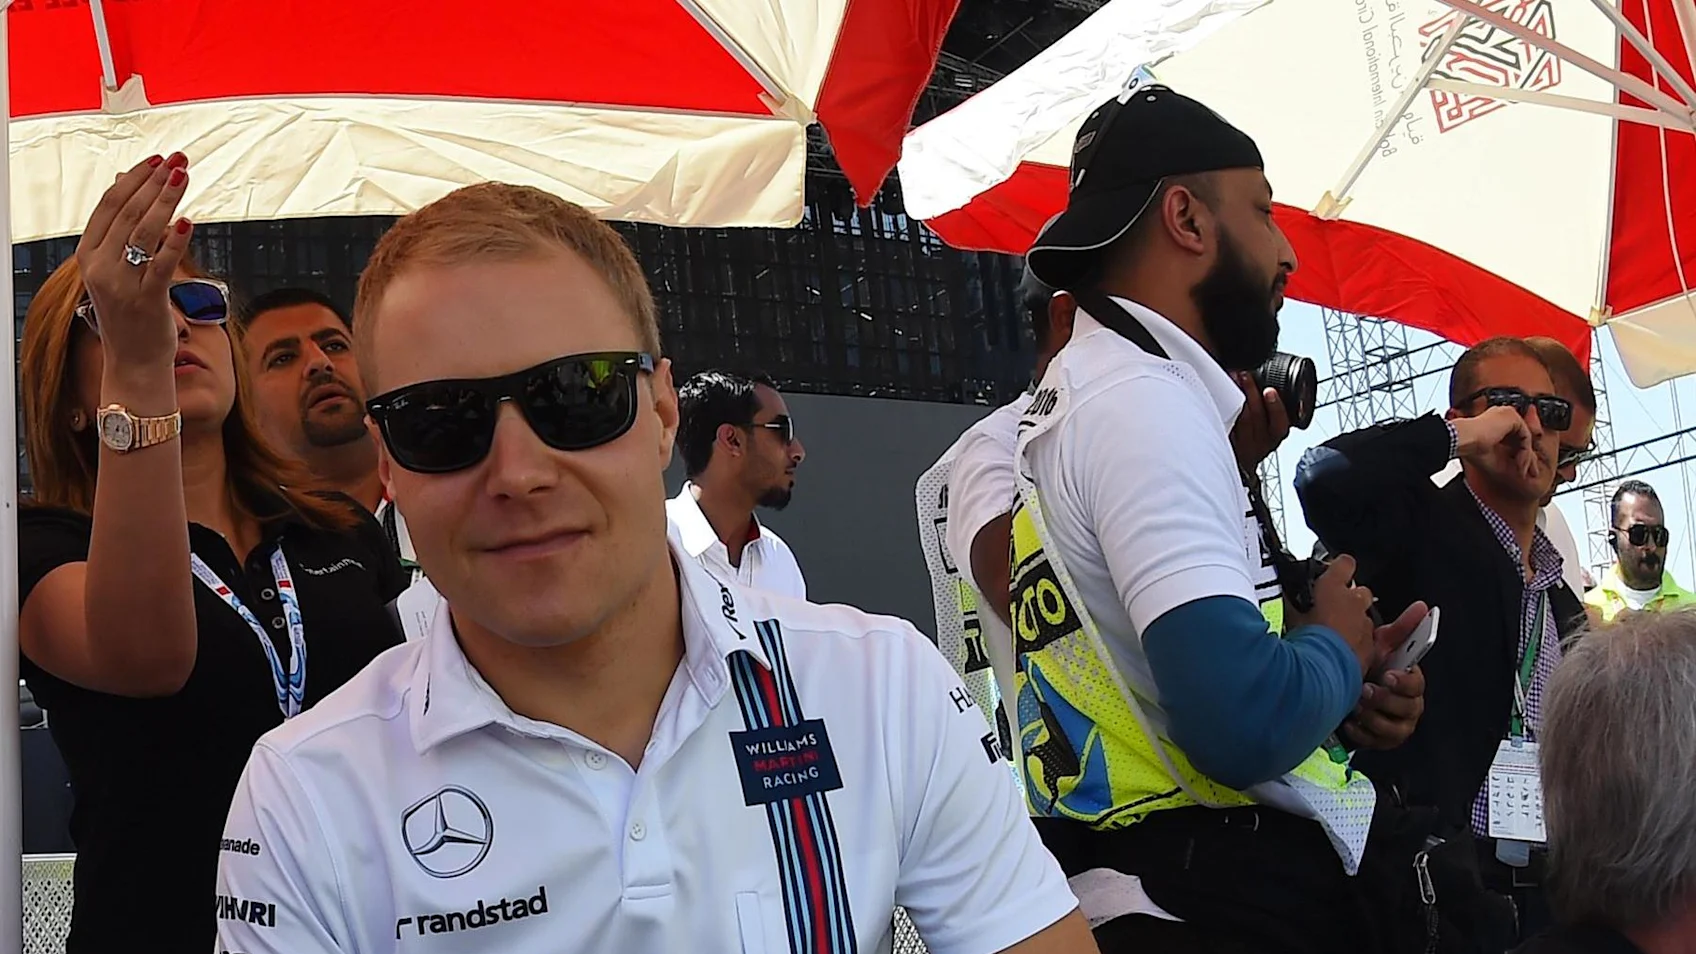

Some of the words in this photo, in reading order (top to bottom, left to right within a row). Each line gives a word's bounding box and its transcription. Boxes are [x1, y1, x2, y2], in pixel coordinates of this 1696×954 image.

[746, 733, 817, 755] WILLIAMS
[752, 750, 819, 772] MARTINI
[763, 766, 819, 789] RACING
[418, 886, 548, 935] randstad
